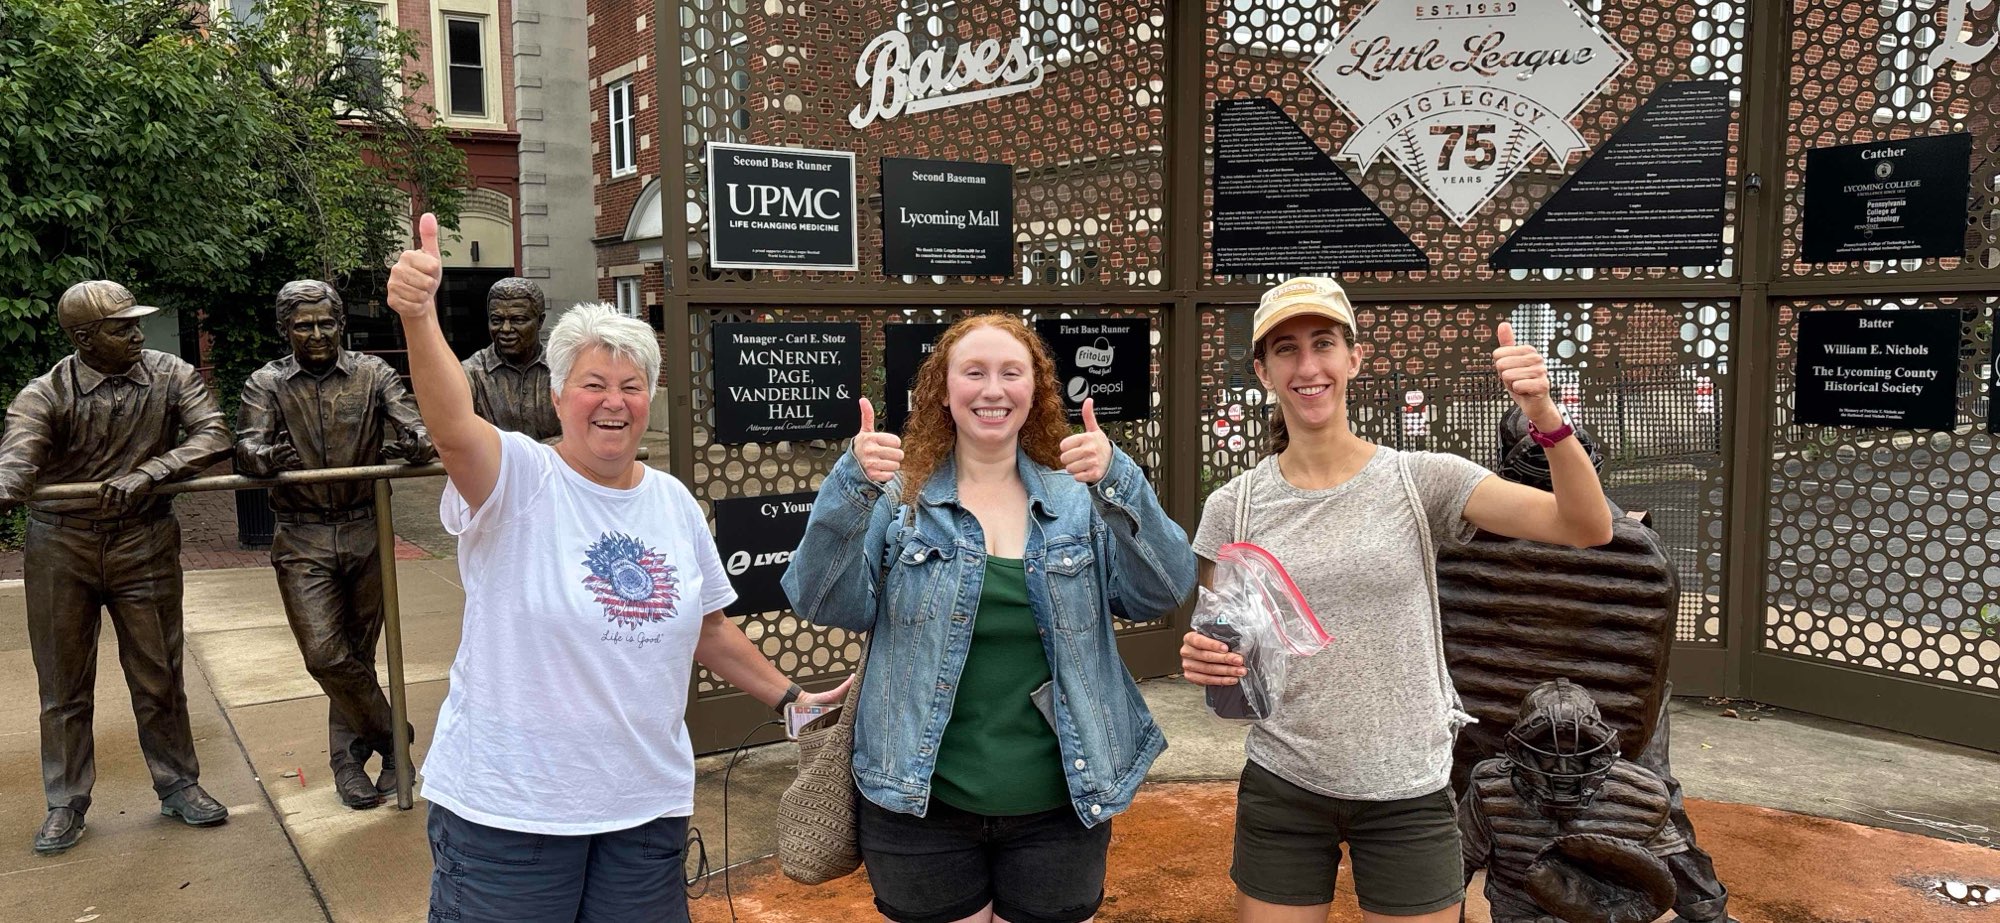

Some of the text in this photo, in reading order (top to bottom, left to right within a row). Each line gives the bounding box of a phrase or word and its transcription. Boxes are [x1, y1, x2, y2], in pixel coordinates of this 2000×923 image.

[1337, 31, 1597, 81] Little League
[848, 30, 1044, 129] Bases
[1386, 90, 1546, 130] BIG LEGACY
[1430, 124, 1496, 170] 75
[1861, 148, 1906, 160] Catcher
[733, 155, 833, 172] Second Base Runner
[912, 170, 986, 184] Second Baseman
[1442, 176, 1482, 184] YEARS
[1844, 180, 1921, 193] LYCOMING COLLEGE
[726, 183, 841, 220] UPMC
[1867, 200, 1906, 208] Pennsylvania
[899, 207, 999, 229] Lycoming Mall
[1867, 208, 1889, 216] College
[729, 220, 840, 232] LIFE CHANGING MEDICINE
[1060, 325, 1130, 334] First Base Runner
[1859, 318, 1894, 328] Batter
[732, 334, 777, 346] Manager
[786, 333, 808, 343] Carl
[810, 333, 820, 343] E.
[822, 333, 846, 343] Stotz
[921, 343, 936, 353] Fir
[1823, 344, 1929, 355] William E. Nichols
[768, 368, 814, 384] PAGE,
[1088, 367, 1101, 375] Good
[1812, 366, 1938, 380] The Lycoming County
[728, 384, 851, 402] VANDERLIN &
[1091, 380, 1123, 396] pepsi
[1824, 381, 1924, 395] Historical Society
[768, 404, 814, 419] HALL
[774, 420, 787, 430] and
[761, 502, 813, 518] Cy Youn
[601, 630, 623, 644] Life
